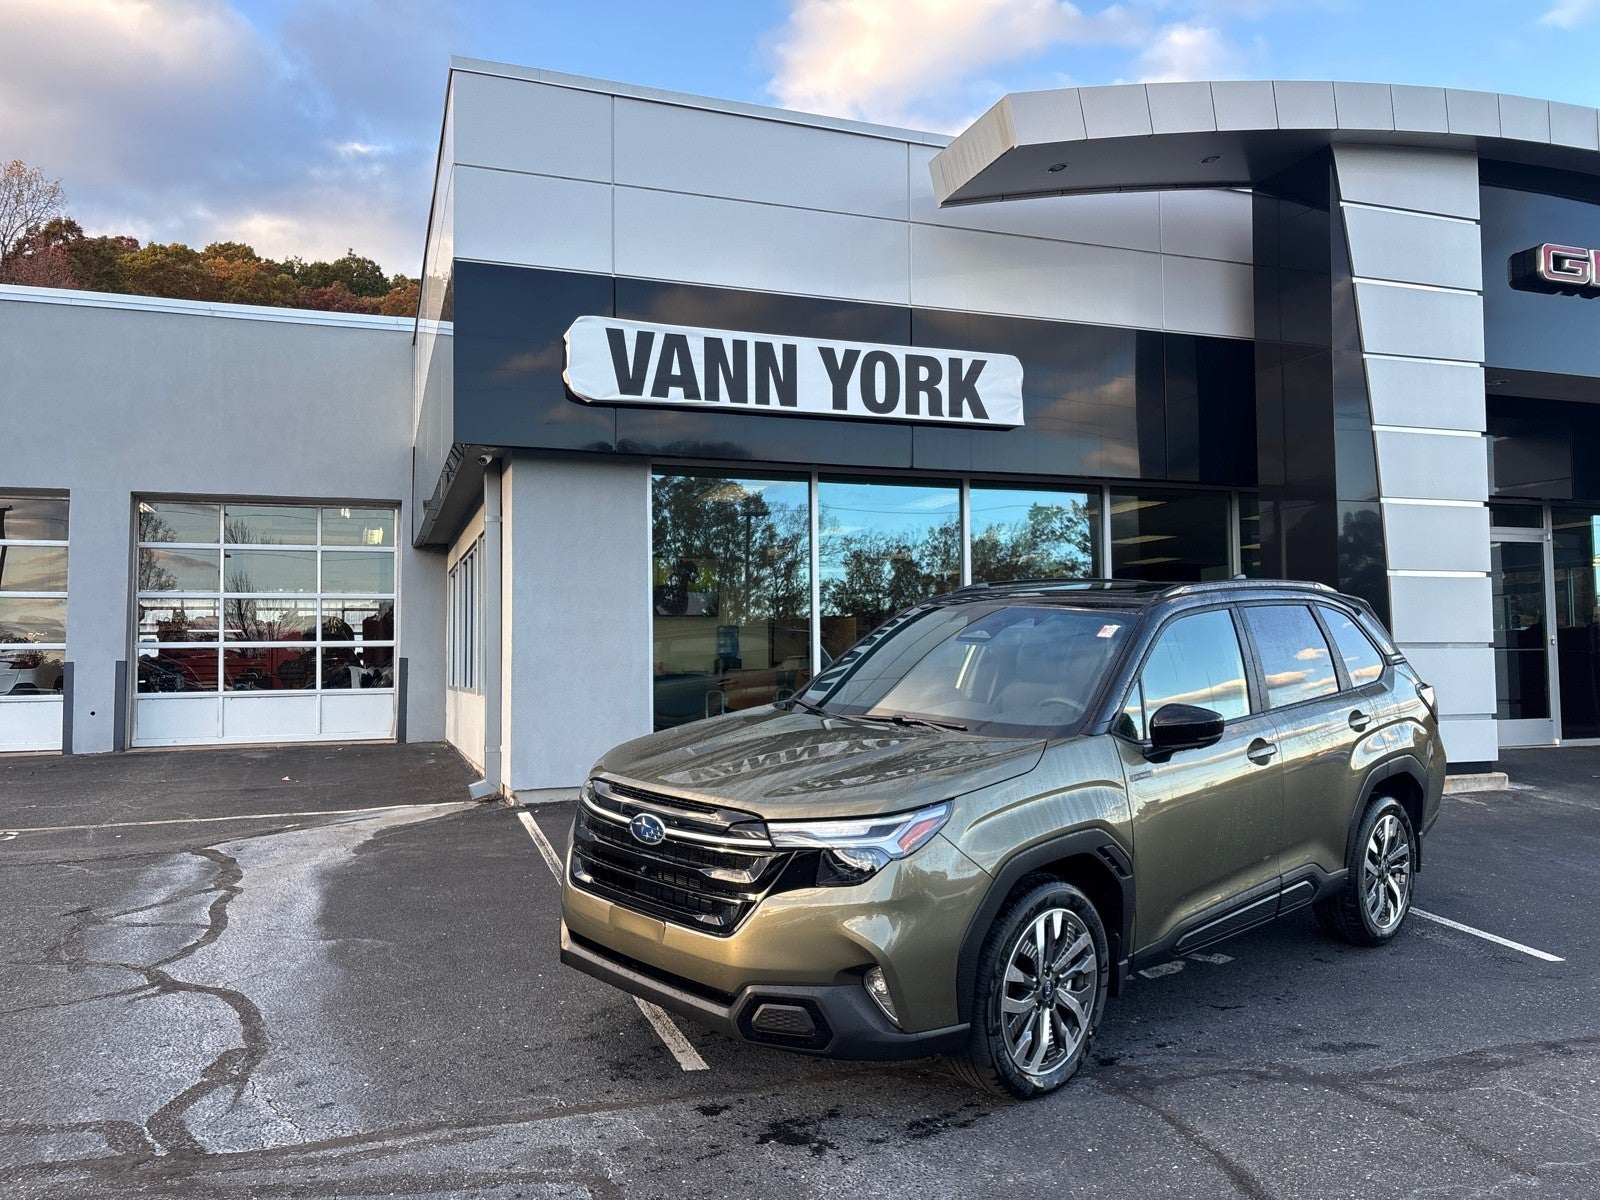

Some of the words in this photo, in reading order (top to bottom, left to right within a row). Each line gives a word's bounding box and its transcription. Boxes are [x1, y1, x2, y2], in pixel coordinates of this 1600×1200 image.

[1538, 243, 1600, 287] G
[605, 327, 797, 407] VANN
[817, 346, 990, 420] YORK
